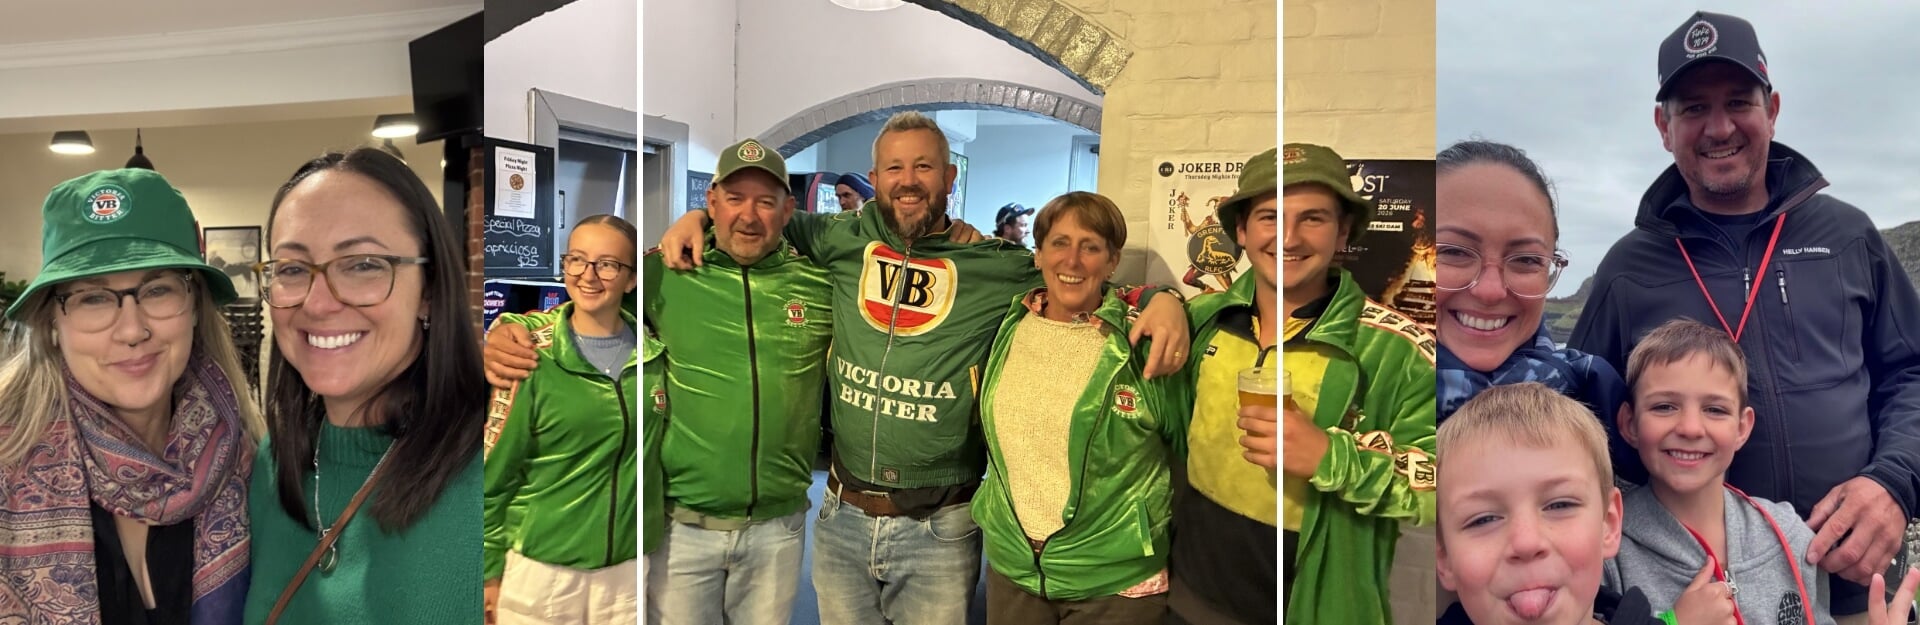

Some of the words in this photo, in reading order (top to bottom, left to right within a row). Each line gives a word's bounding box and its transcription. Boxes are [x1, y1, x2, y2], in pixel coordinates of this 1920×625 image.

[1178, 162, 1220, 173] JOKER
[1225, 162, 1244, 173] DR
[88, 188, 125, 203] VICTORIA
[96, 200, 117, 209] VB
[1168, 189, 1176, 230] JOKER
[89, 210, 123, 220] BITTER
[484, 214, 514, 231] Special
[516, 219, 541, 233] Pizza
[1197, 227, 1226, 238] GRENF
[484, 241, 538, 256] apricciosa
[517, 255, 539, 267] $25
[877, 260, 936, 308] VB
[790, 309, 802, 317] VB
[837, 356, 957, 399] VICTORIA
[840, 384, 938, 422] BITTER
[1119, 396, 1134, 407] VB
[1779, 591, 1801, 609] RIP
[1778, 604, 1802, 621] CURL
